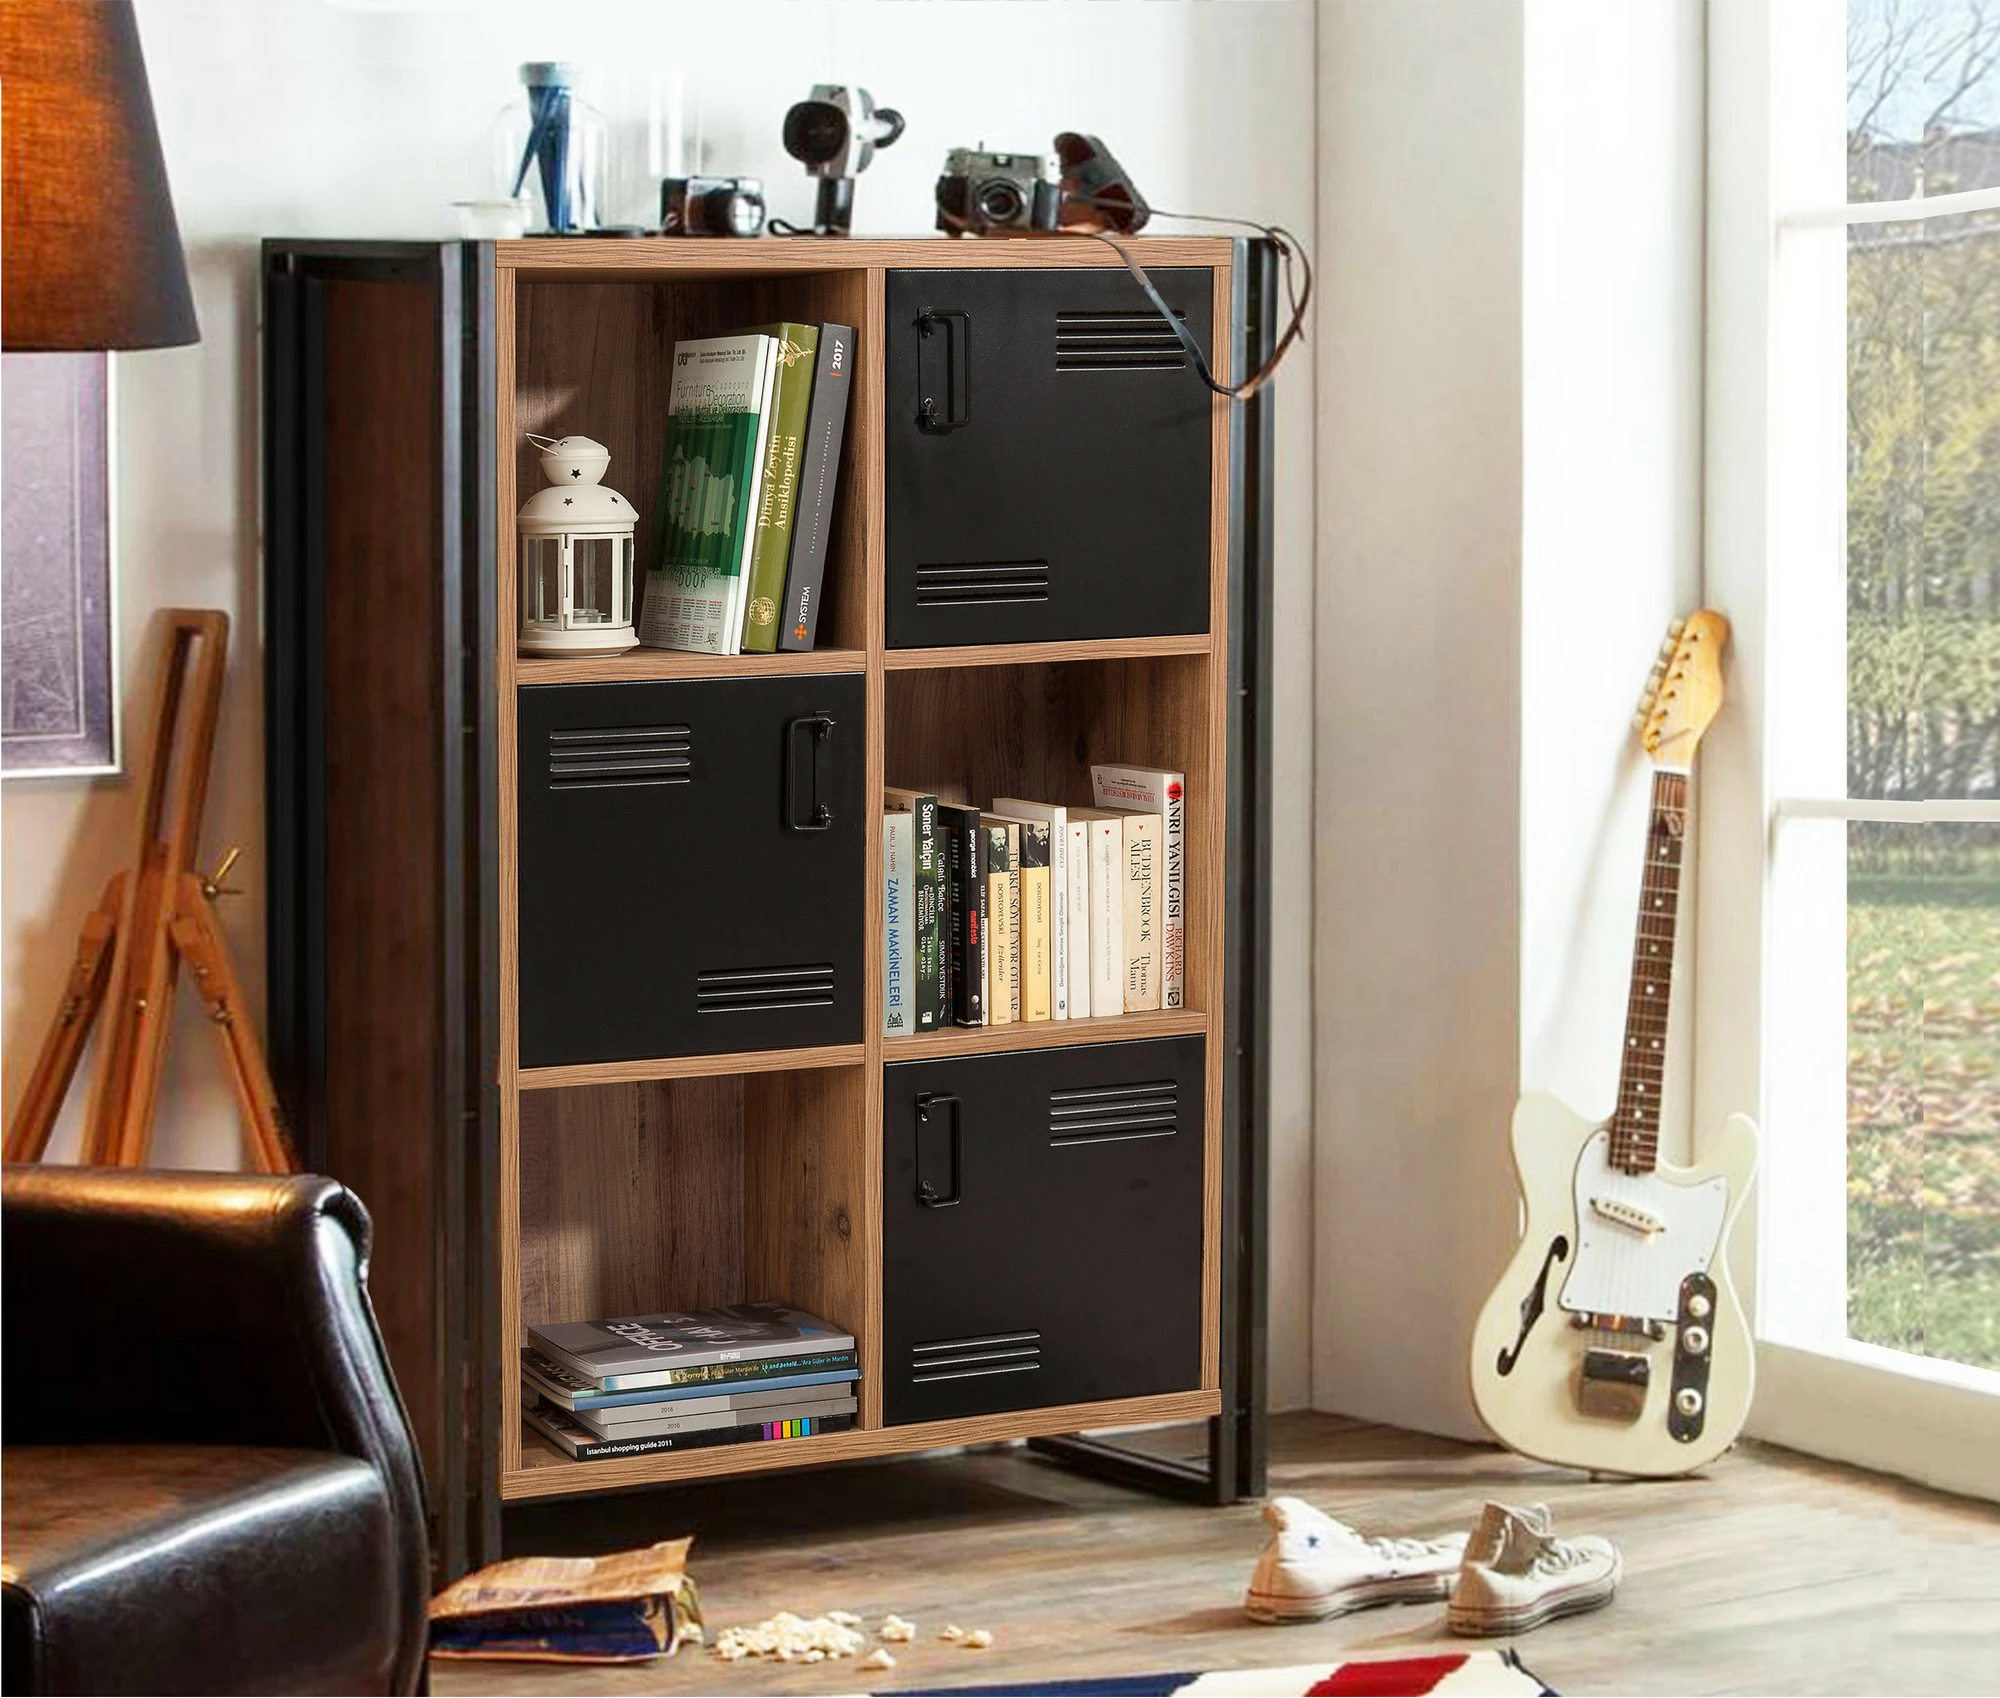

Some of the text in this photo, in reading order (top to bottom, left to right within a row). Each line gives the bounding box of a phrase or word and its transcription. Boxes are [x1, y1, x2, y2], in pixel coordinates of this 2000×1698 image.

[832, 339, 844, 370] 2017
[677, 380, 711, 399] Furniture
[708, 389, 746, 407] Decoration
[758, 434, 782, 529] Dünya Zeytin
[774, 435, 797, 531] Ansiklopedisi
[678, 571, 706, 588] DOOR
[798, 586, 811, 624] SYSTEM
[918, 803, 934, 870] Soner Yalçın
[1168, 786, 1181, 918] TANRI YANILGISI
[1130, 839, 1142, 881] AİLESİ
[928, 893, 936, 925] DİNCİLER
[1141, 839, 1152, 942] BUDDENBROOK
[887, 877, 903, 1007] ZAMAN MAKİNELERİ
[969, 910, 979, 945] manifesto
[997, 883, 1005, 983] DOSTOYEVSKİ Ezilenler
[1165, 923, 1175, 982] DAWKINS
[1175, 928, 1183, 976] RICHARD
[1130, 958, 1140, 991] Mann
[1140, 952, 1151, 996] Thomas
[606, 1322, 684, 1351] OFFICE
[769, 1362, 779, 1370] and
[611, 1443, 640, 1453] shopping
[640, 1441, 657, 1451] guide
[658, 1439, 672, 1448] 2011
